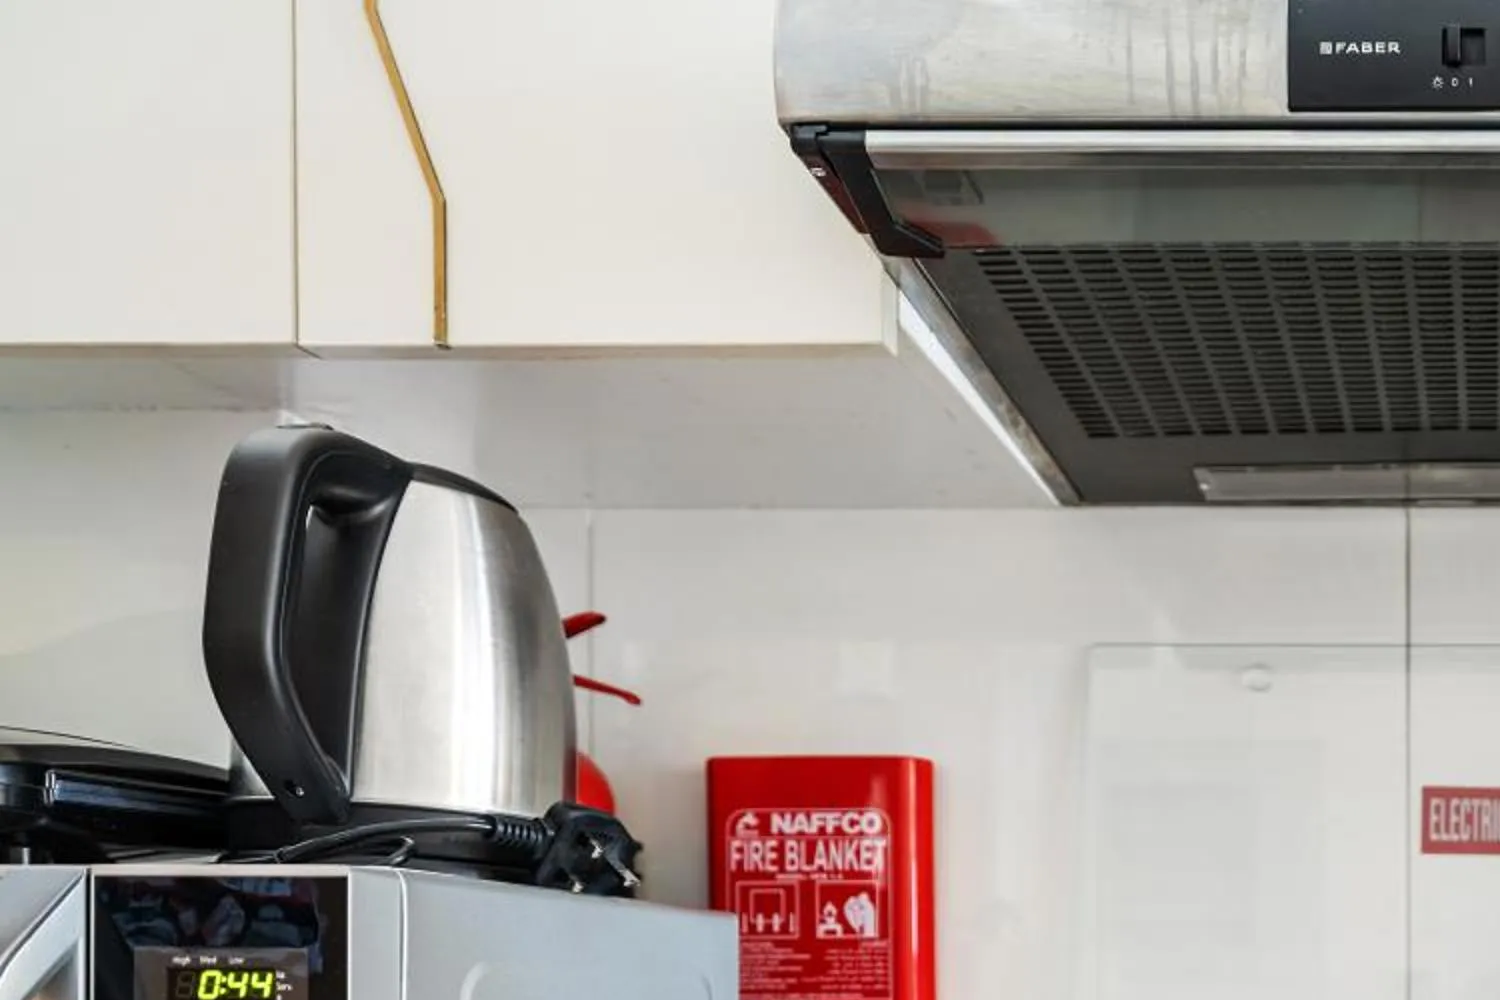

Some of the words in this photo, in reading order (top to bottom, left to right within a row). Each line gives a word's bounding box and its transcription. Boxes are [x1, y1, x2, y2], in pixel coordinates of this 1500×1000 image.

[1335, 41, 1401, 54] FABER
[771, 812, 882, 834] NAFFCO
[730, 838, 779, 872] FIRE
[784, 838, 887, 873] BLANKET
[197, 969, 273, 1000] 0:44
